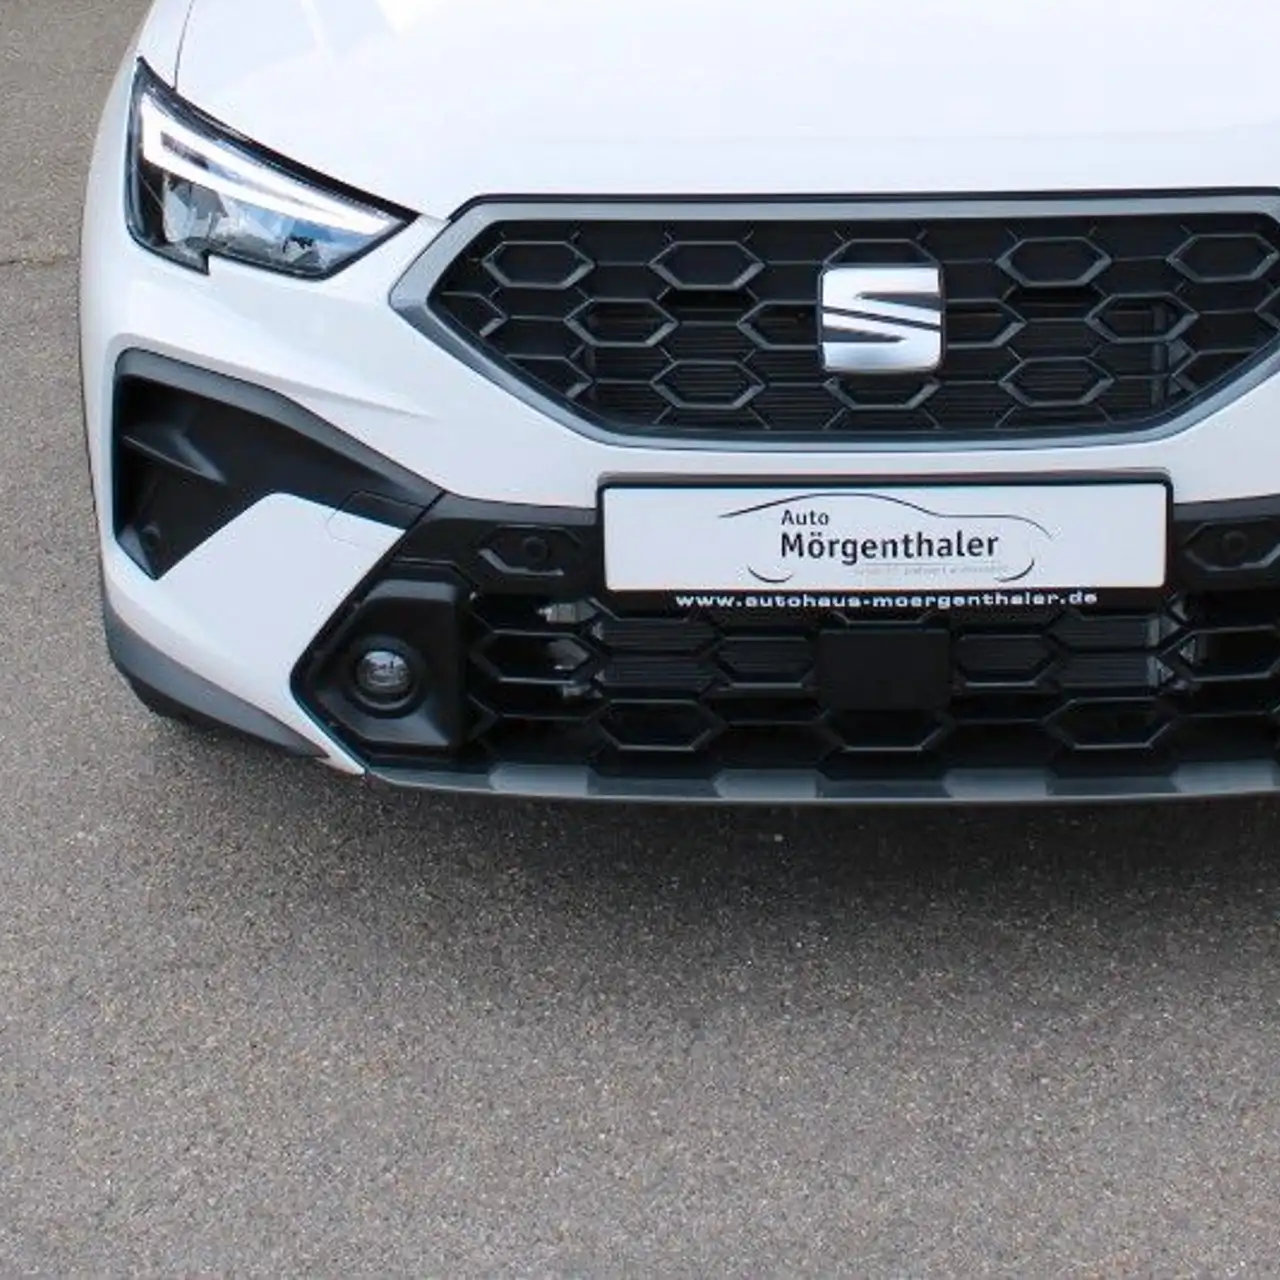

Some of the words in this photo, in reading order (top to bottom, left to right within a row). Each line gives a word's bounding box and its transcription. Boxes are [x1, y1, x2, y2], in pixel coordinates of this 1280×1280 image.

[780, 509, 830, 526] Auto
[781, 530, 999, 565] Mörgenthaler
[675, 591, 1098, 609] www.autohaus-moergenthaler.de
